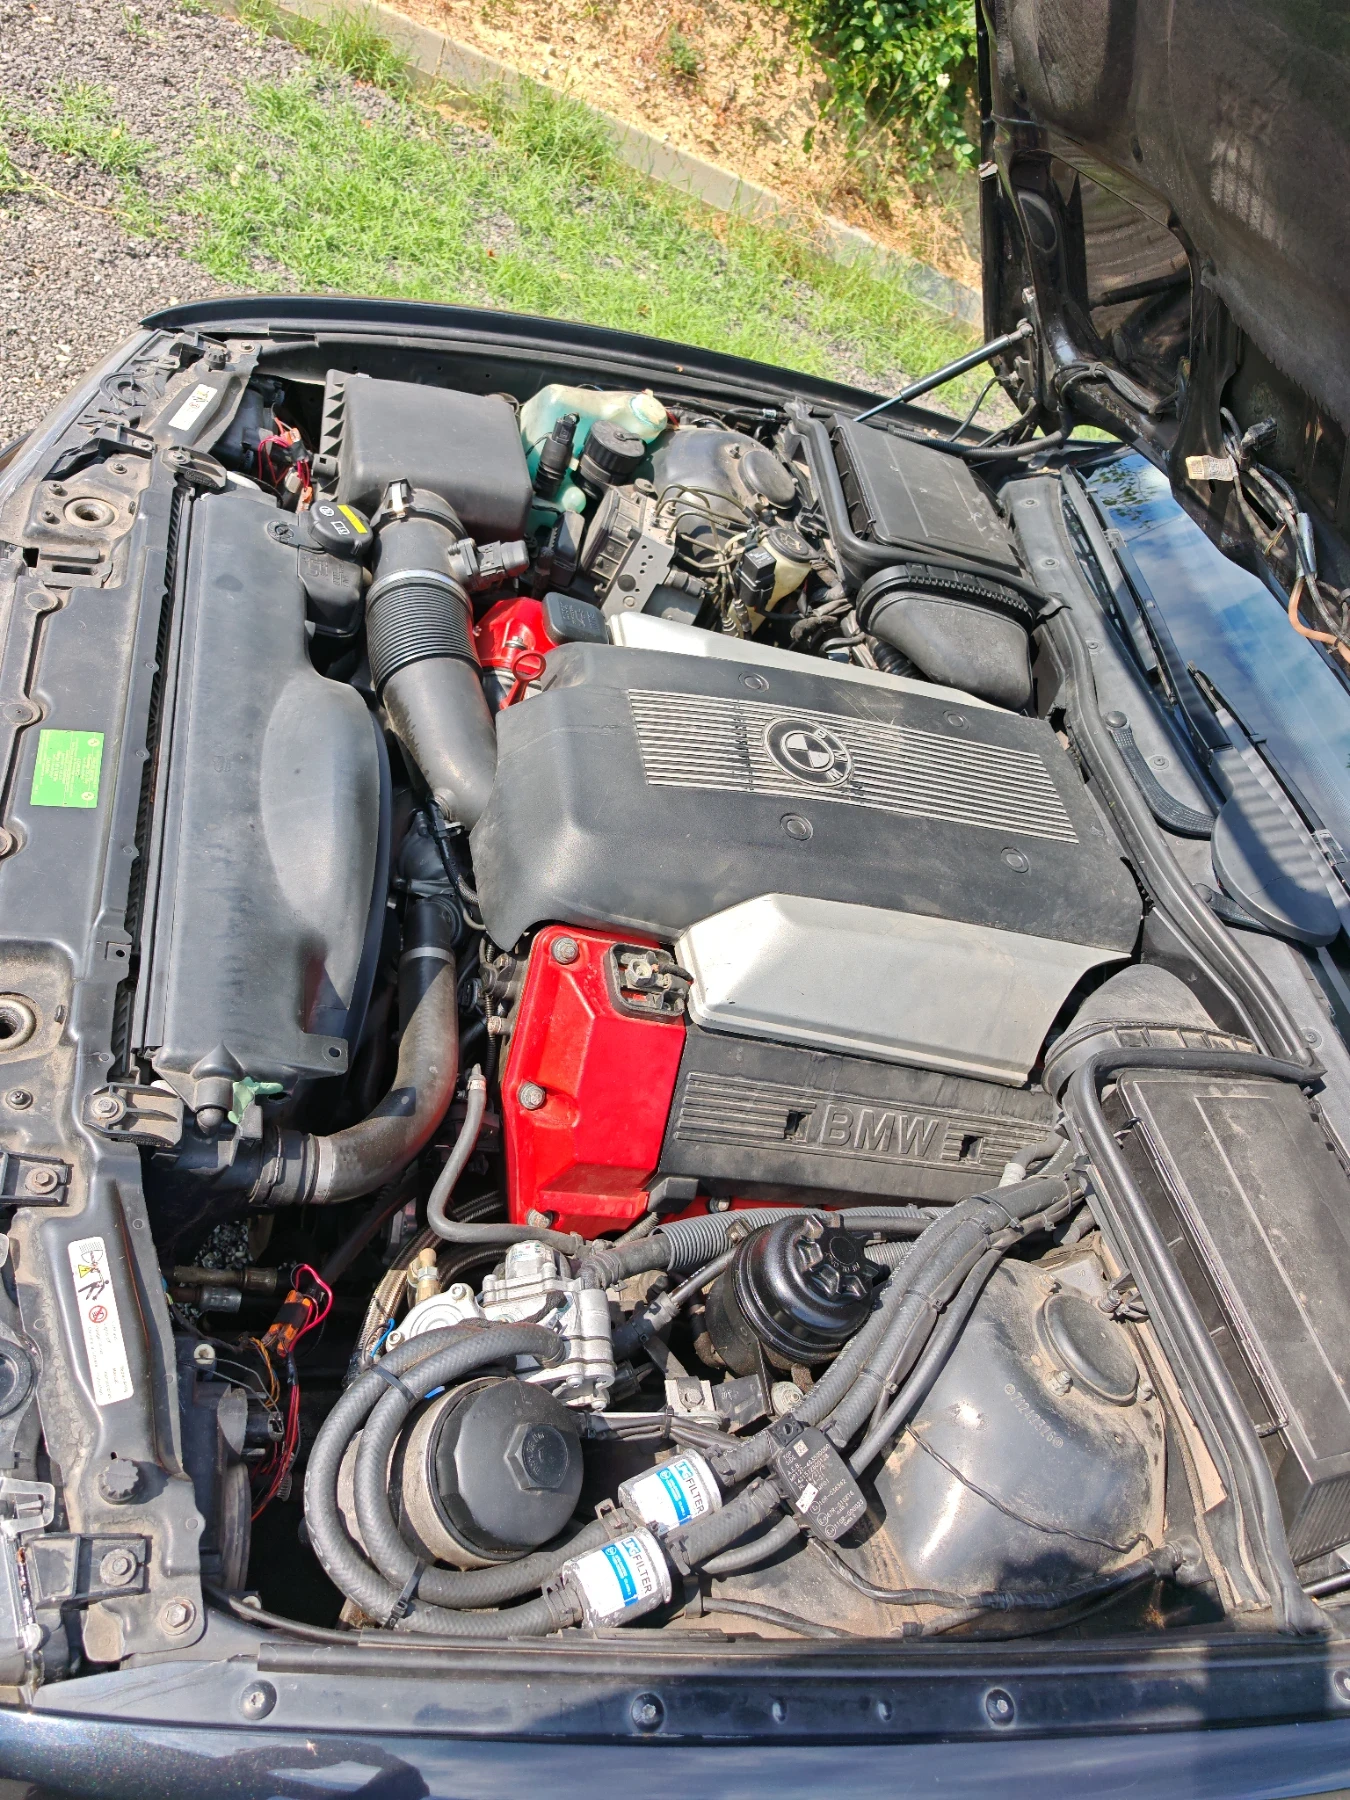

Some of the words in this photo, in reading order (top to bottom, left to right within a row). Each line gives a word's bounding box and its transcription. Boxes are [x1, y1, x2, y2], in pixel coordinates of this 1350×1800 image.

[820, 1104, 939, 1157] BMW
[686, 1477, 705, 1514] FILTER
[633, 1554, 653, 1594] FILTER
